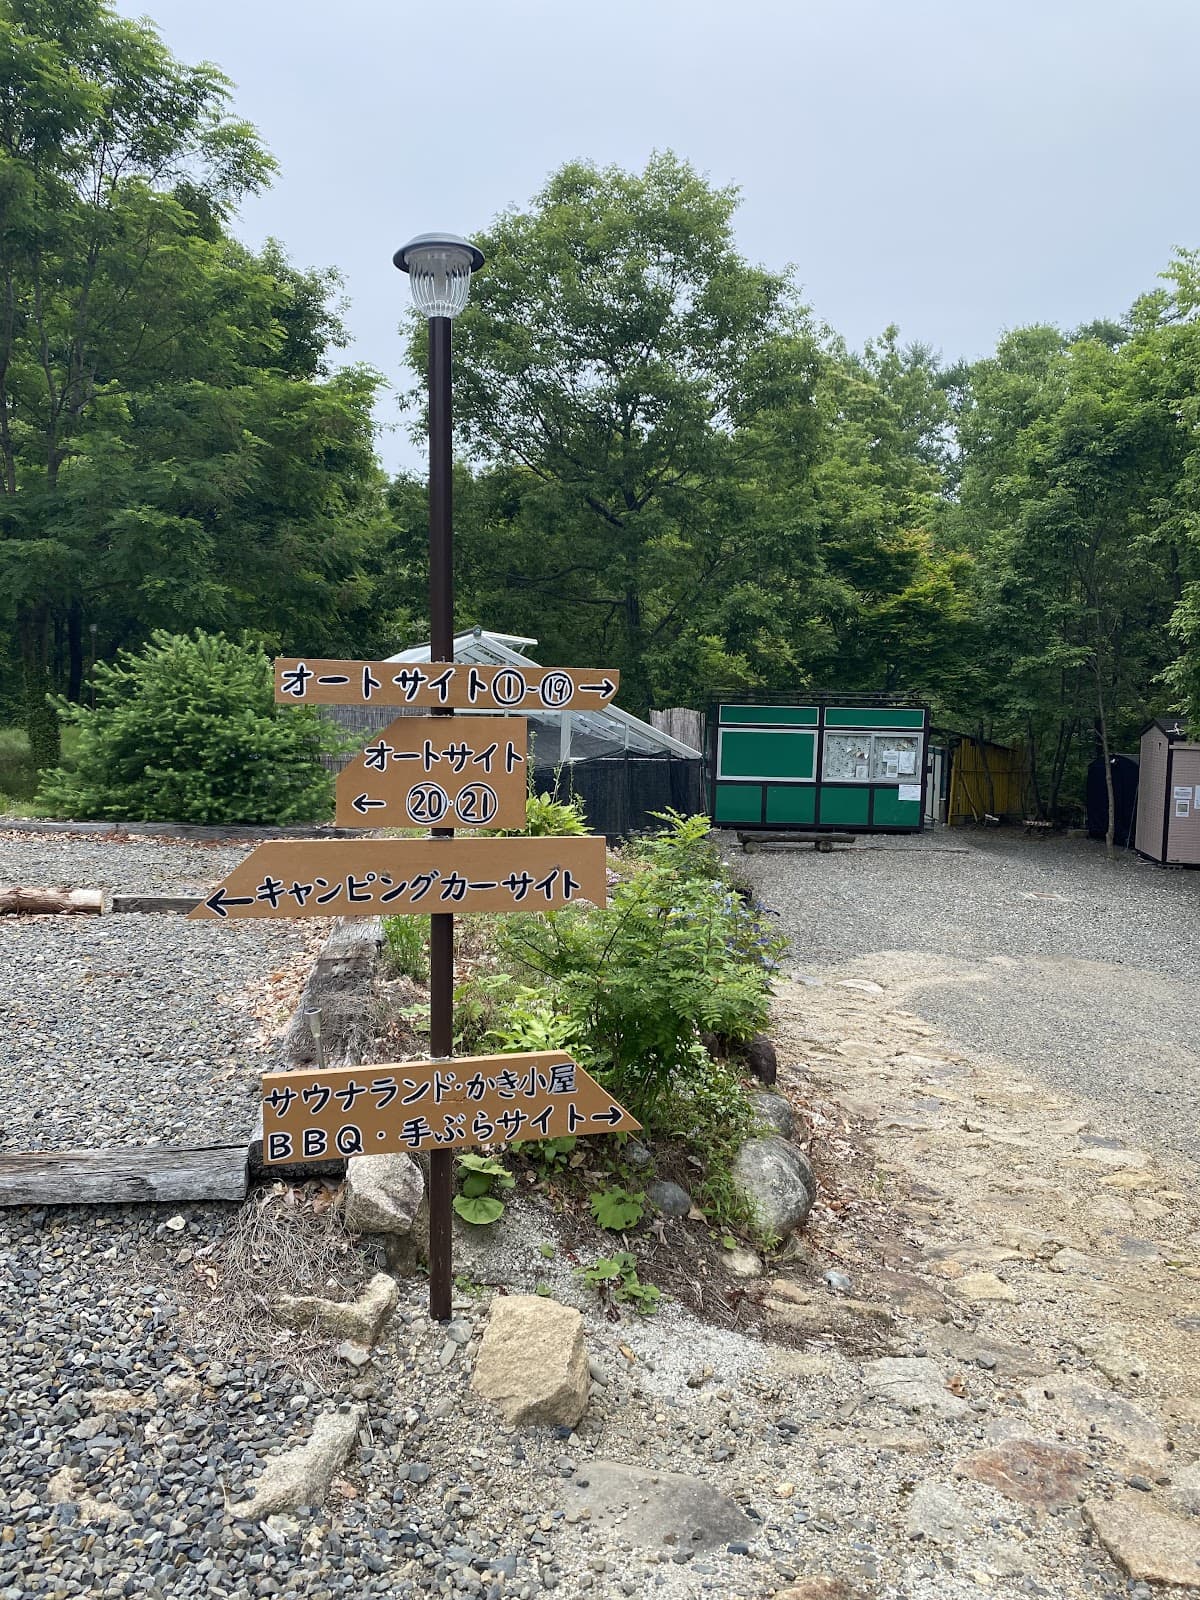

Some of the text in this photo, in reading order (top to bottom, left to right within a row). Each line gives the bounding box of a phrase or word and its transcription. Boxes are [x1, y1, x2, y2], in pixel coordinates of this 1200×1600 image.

[364, 740, 524, 774] オートサイト
[256, 870, 581, 909] キャンピングカーサイト
[264, 1063, 578, 1118] サウナランド・かき小屋
